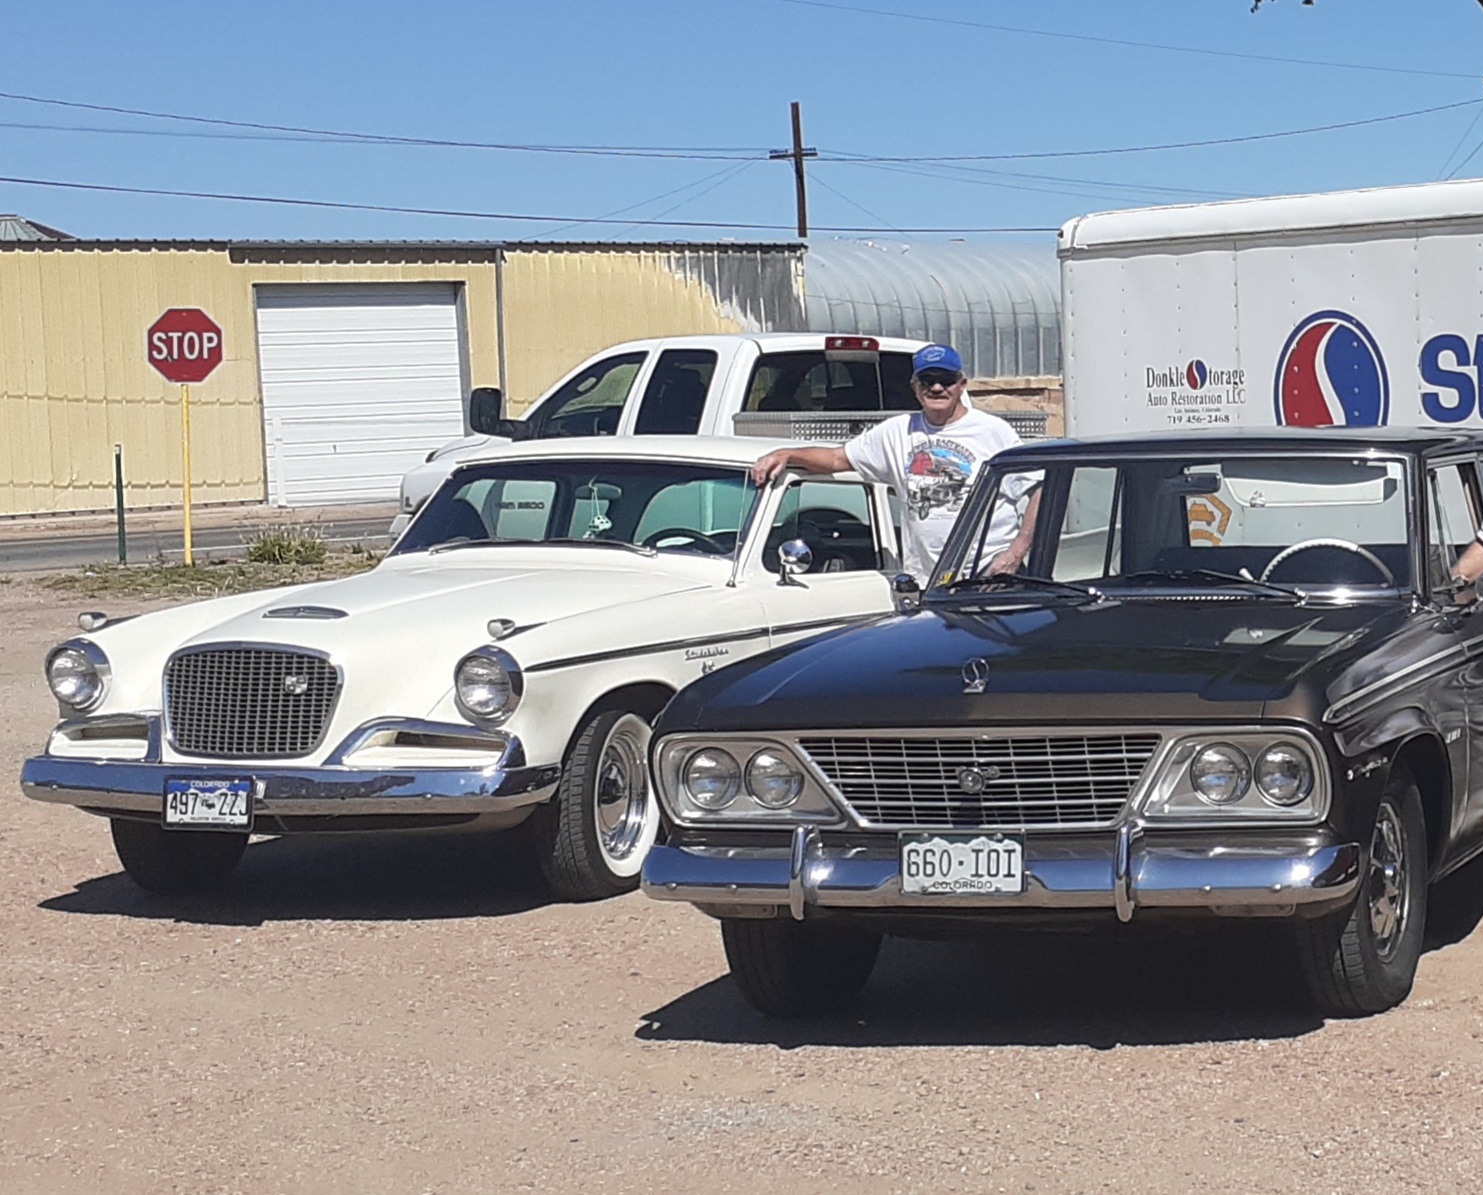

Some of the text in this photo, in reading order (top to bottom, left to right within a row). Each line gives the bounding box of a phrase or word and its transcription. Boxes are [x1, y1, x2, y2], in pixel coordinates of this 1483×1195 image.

[152, 331, 218, 360] STOP
[1146, 366, 1185, 388] Donkle
[1147, 389, 1246, 406] Auto Restoration LLC
[169, 792, 199, 815] 497
[933, 880, 993, 890] COLORADO
